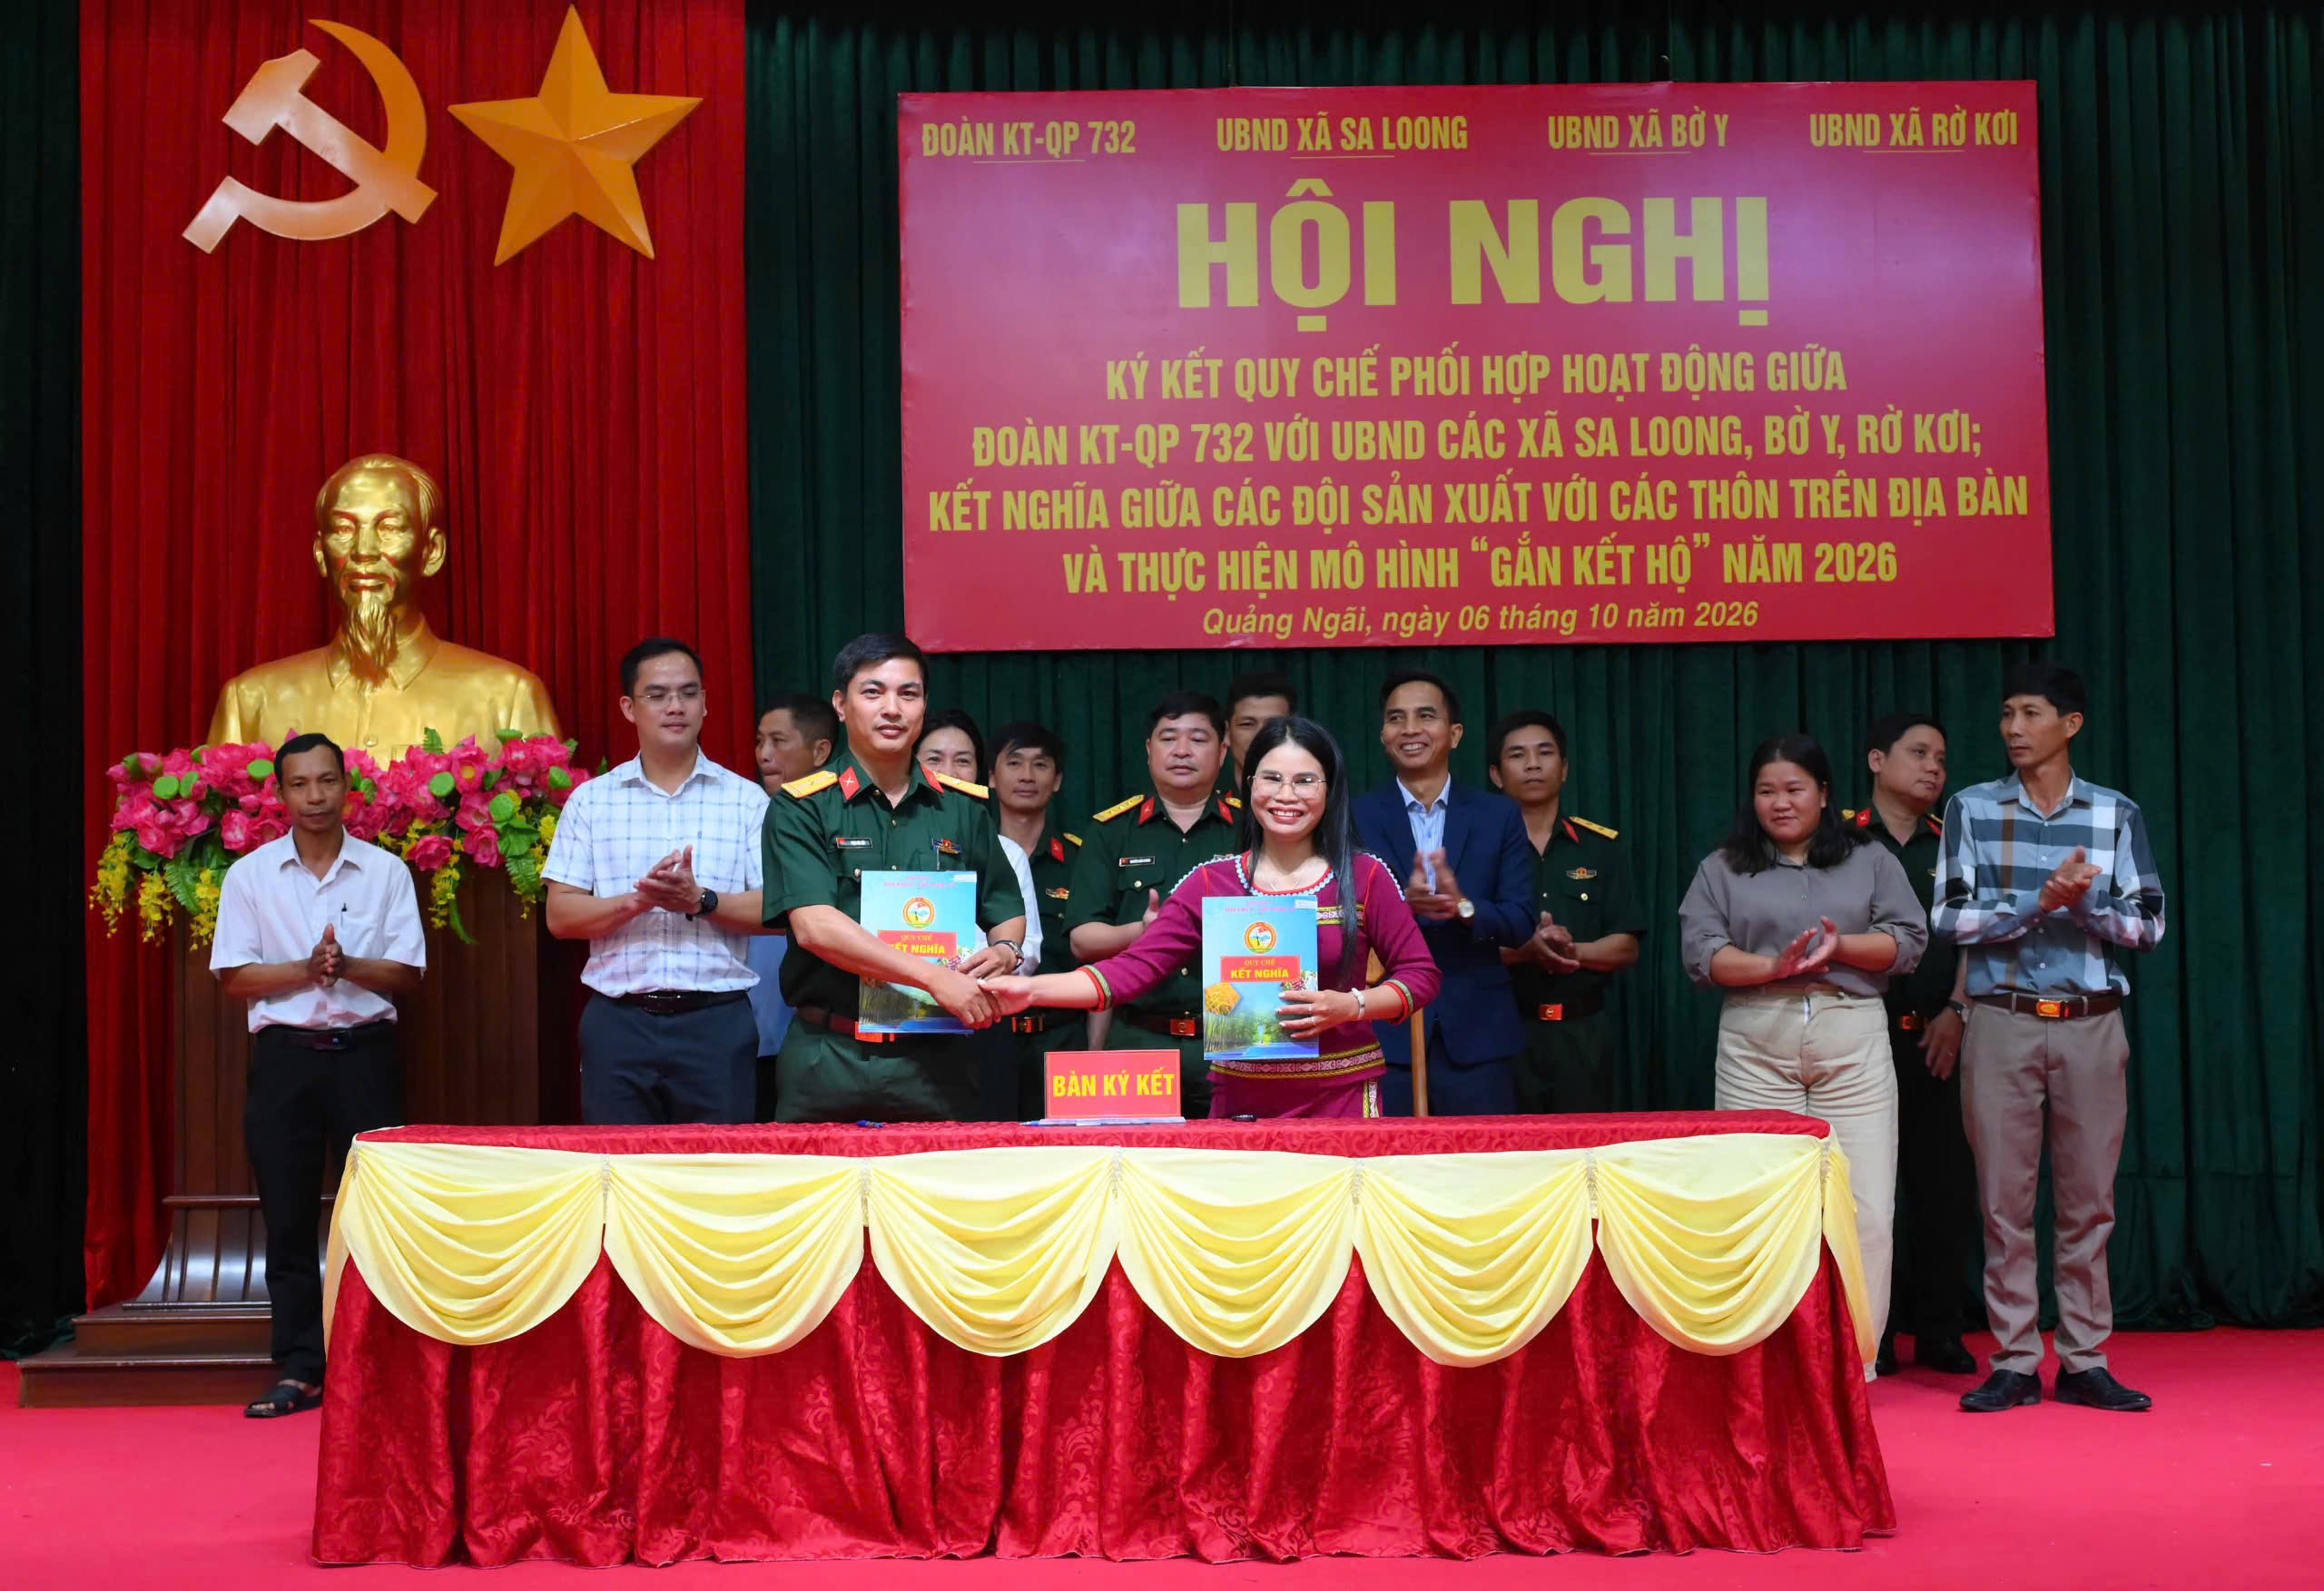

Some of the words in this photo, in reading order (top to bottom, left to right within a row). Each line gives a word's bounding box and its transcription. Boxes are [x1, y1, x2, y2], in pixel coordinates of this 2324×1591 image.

[922, 119, 994, 156] ĐOÀN
[1004, 122, 1079, 156] KT-QP
[1089, 121, 1136, 152] 732
[1217, 118, 1288, 151] UBND
[1297, 112, 1333, 151] XÃ
[1341, 117, 1374, 151] SA
[1383, 116, 1467, 150] LOONG
[1549, 116, 1619, 149] UBND
[1629, 109, 1663, 148] XÃ
[1672, 106, 1706, 146] BỜ
[1714, 114, 1728, 145] Y
[1811, 113, 1880, 145] UBND
[1889, 107, 1924, 145] XÃ
[1932, 106, 1966, 145] RỜ
[1975, 109, 2017, 145] KƠI
[1178, 178, 1396, 331] HỘI
[1449, 198, 1768, 326] NGHỊ
[1108, 353, 1147, 399] KÝ
[1162, 347, 1224, 399] KẾT
[1236, 358, 1300, 403] QUY
[1314, 346, 1380, 398] CHẾ
[1390, 341, 1471, 396] PHỐI
[1483, 351, 1551, 404] HỢP
[1563, 353, 1650, 402] HOẠT
[1661, 346, 1755, 399] ĐỘNG
[1768, 345, 1846, 390] GIỮA
[973, 418, 1068, 466] ĐOÀN
[1080, 424, 1179, 468] KT-QP
[1191, 421, 1255, 464] 732
[1265, 414, 1320, 462] VỚI
[1332, 421, 1425, 461] UBND
[1438, 410, 1506, 460] CÁC
[1518, 410, 1564, 458] XÃ
[1576, 417, 1620, 457] SA
[1630, 416, 1753, 460] LOONG,
[1765, 407, 1810, 455] BỜ
[1823, 414, 1845, 457] Y,
[1859, 407, 1903, 454] RỜ
[1915, 410, 1981, 457] KƠI;
[930, 479, 992, 531] KẾT
[1002, 481, 1110, 530] NGHĨA
[1121, 479, 1202, 528] GIỮA
[1213, 477, 1281, 526] CÁC
[1293, 476, 1351, 535] ĐỘI
[1362, 471, 1433, 525] SẢN
[1445, 468, 1532, 523] XUẤT
[1542, 473, 1598, 522] VỚI
[1610, 472, 1677, 521] CÁC
[1689, 470, 1778, 519] THÔN
[1790, 469, 1877, 518] TRÊN
[1888, 477, 1946, 526] ĐỊA
[1958, 468, 2027, 516] BÀN
[1062, 545, 1108, 594] VÀ
[1118, 547, 1206, 602] THỰC
[1218, 542, 1298, 599] HIỆN
[1310, 540, 1364, 589] MÔ
[1376, 539, 1459, 588] HÌNH
[1471, 531, 1561, 587] “GẮN
[1573, 532, 1635, 585] KẾT
[1647, 533, 1710, 593] HỘ”
[1723, 535, 1802, 583] NĂM
[1816, 542, 1897, 582] 2026
[1204, 604, 1293, 639] Quảng
[1303, 606, 1372, 639] Ngãi,
[1383, 604, 1451, 638] ngày
[1460, 605, 1490, 631] 06
[1500, 603, 1577, 635] tháng
[1590, 603, 1619, 628] 10
[1627, 603, 1685, 627] năm
[1694, 601, 1758, 626] 2026
[890, 941, 909, 952] ẾT
[1255, 967, 1290, 979] NGHĨA
[1052, 1069, 1097, 1097] BÀN
[1103, 1069, 1129, 1096] KÝ
[1137, 1066, 1175, 1096] KẾT
